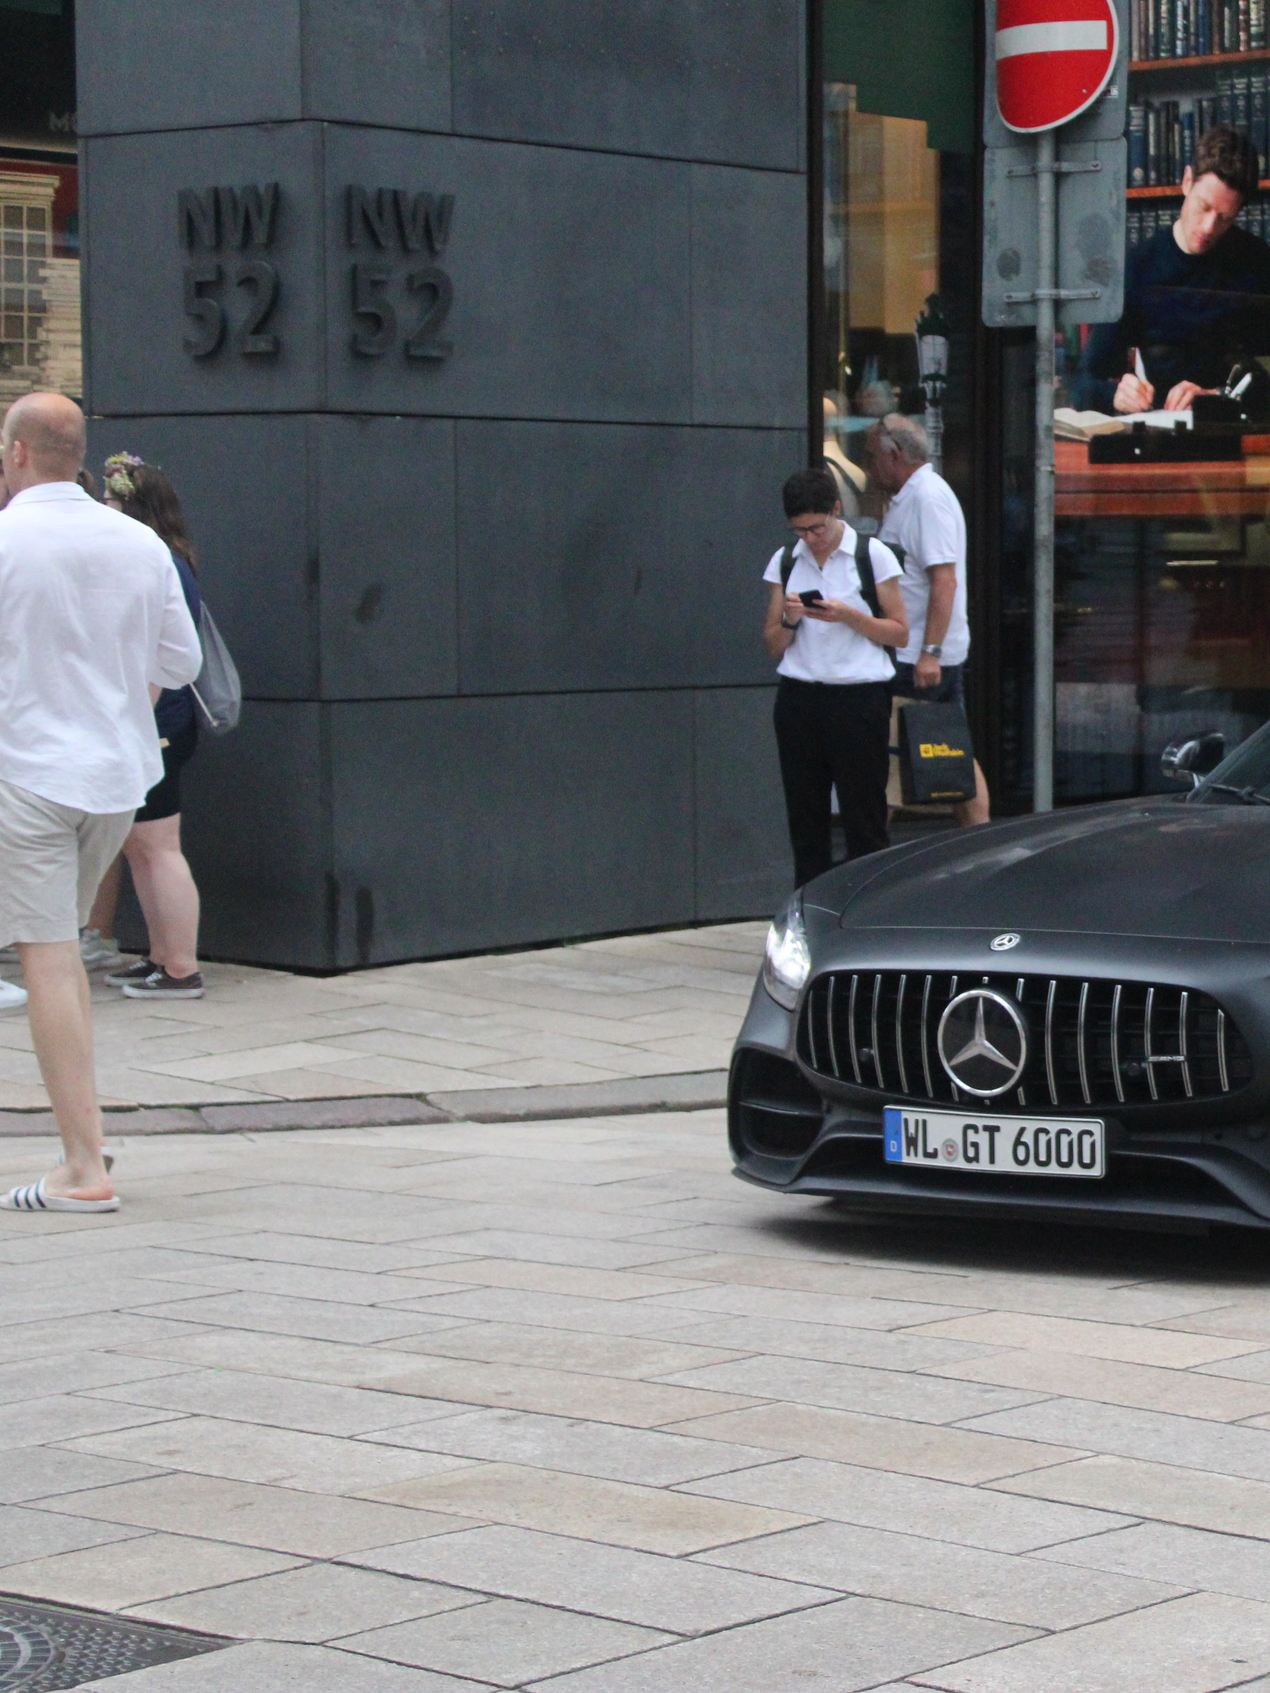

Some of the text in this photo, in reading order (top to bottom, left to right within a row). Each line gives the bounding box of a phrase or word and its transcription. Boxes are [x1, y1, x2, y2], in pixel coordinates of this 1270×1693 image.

[178, 182, 280, 254] NW
[346, 184, 454, 258] NW
[183, 260, 281, 357] 52
[350, 262, 454, 360] 52
[903, 1117, 1096, 1169] WL GT 6000
